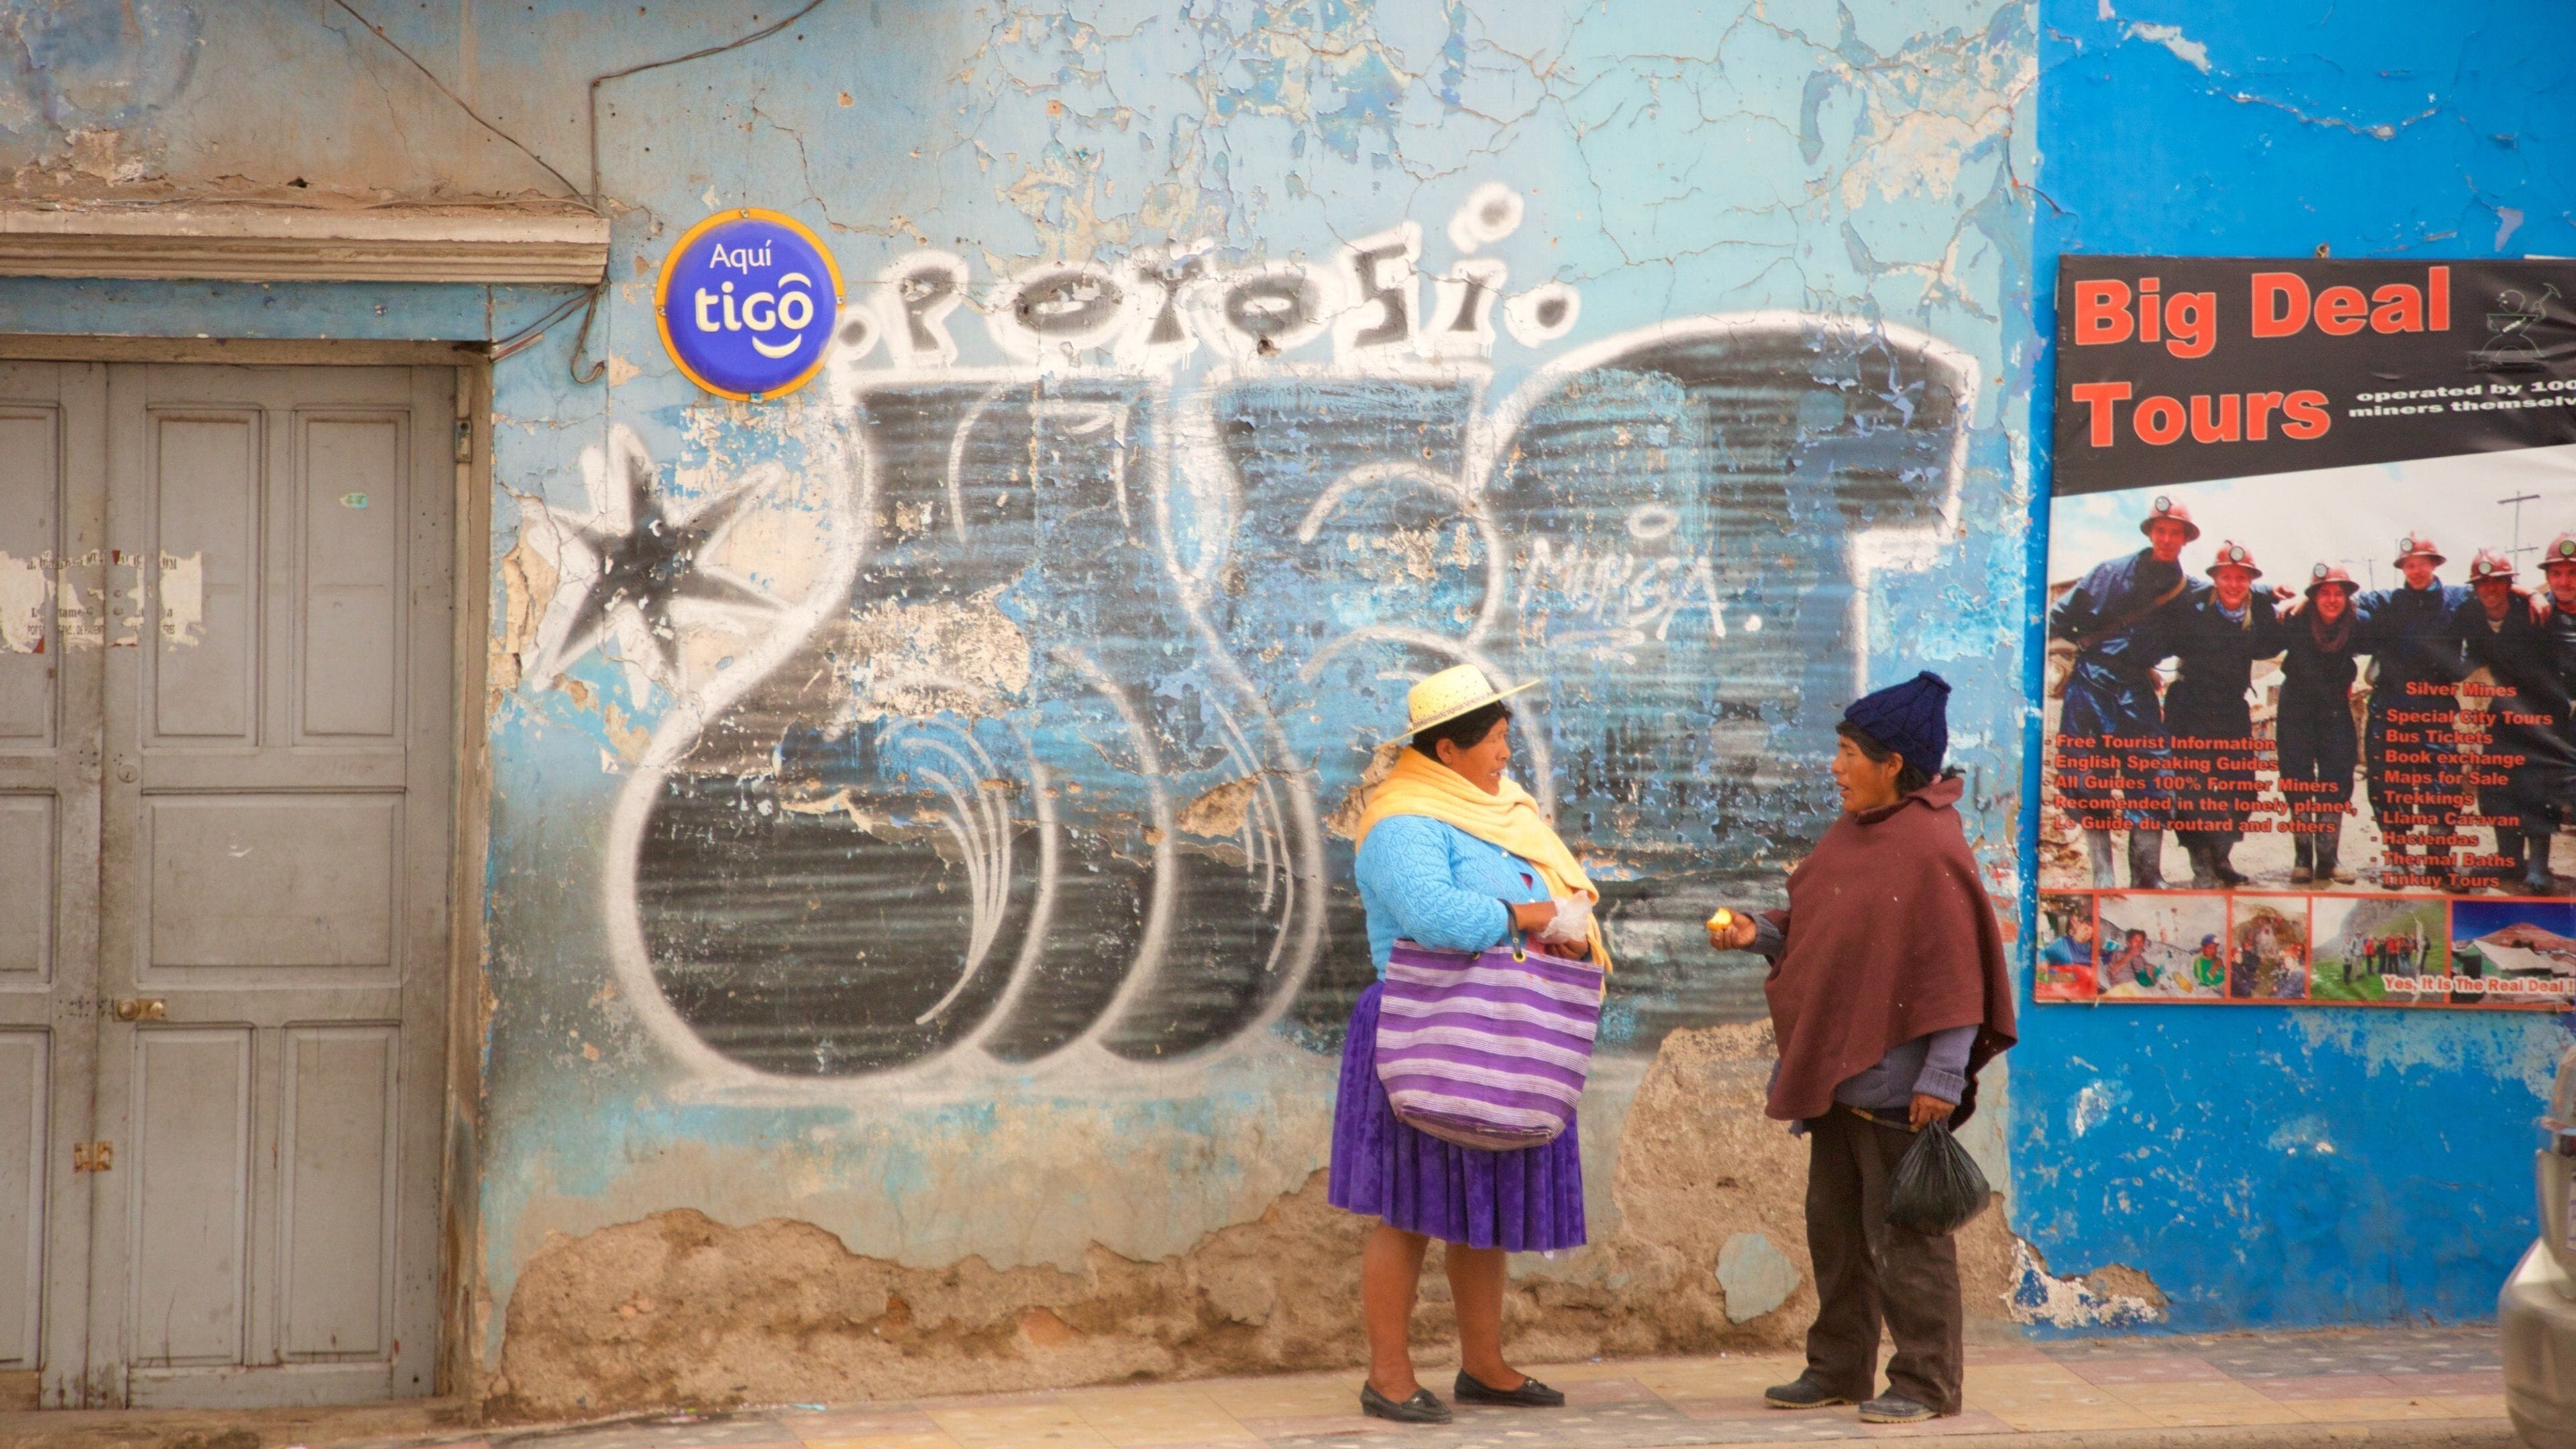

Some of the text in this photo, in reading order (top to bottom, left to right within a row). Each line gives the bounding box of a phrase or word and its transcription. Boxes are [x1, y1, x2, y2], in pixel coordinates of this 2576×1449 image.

[709, 239, 771, 275] Aquí
[2074, 266, 2451, 359] Big Deal
[2357, 385, 2482, 402] operated
[2489, 384, 2522, 395] by
[2072, 381, 2331, 447] Tours
[2349, 404, 2444, 417] miners
[2406, 682, 2517, 697] Silver Mines
[2386, 709, 2553, 727] Special City Tours
[2055, 733, 2276, 750] Free Tourist Information
[2385, 730, 2493, 744] Bus Tickets
[2054, 754, 2279, 773] English Speaking Guides
[2385, 750, 2526, 768] Book exchange
[2054, 775, 2339, 792] All Guides 100% Former Miners
[2384, 771, 2509, 786] Maps for Sale
[2054, 794, 2357, 816] Recomended in the lonely planet,
[2383, 790, 2475, 809] Trekkings
[2054, 816, 2336, 833] Le Guide du routard and others
[2383, 810, 2520, 826] Llama Caravan
[2381, 832, 2479, 847] Haciendas
[2381, 851, 2515, 867] Thermal Baths
[2381, 872, 2500, 888] Tinkuy Tours
[2384, 976, 2417, 991] Yes,
[2422, 977, 2433, 989] It
[2438, 977, 2451, 990] Is
[2455, 978, 2483, 991] The
[2488, 978, 2523, 991] Real
[2528, 979, 2563, 992] Deal
